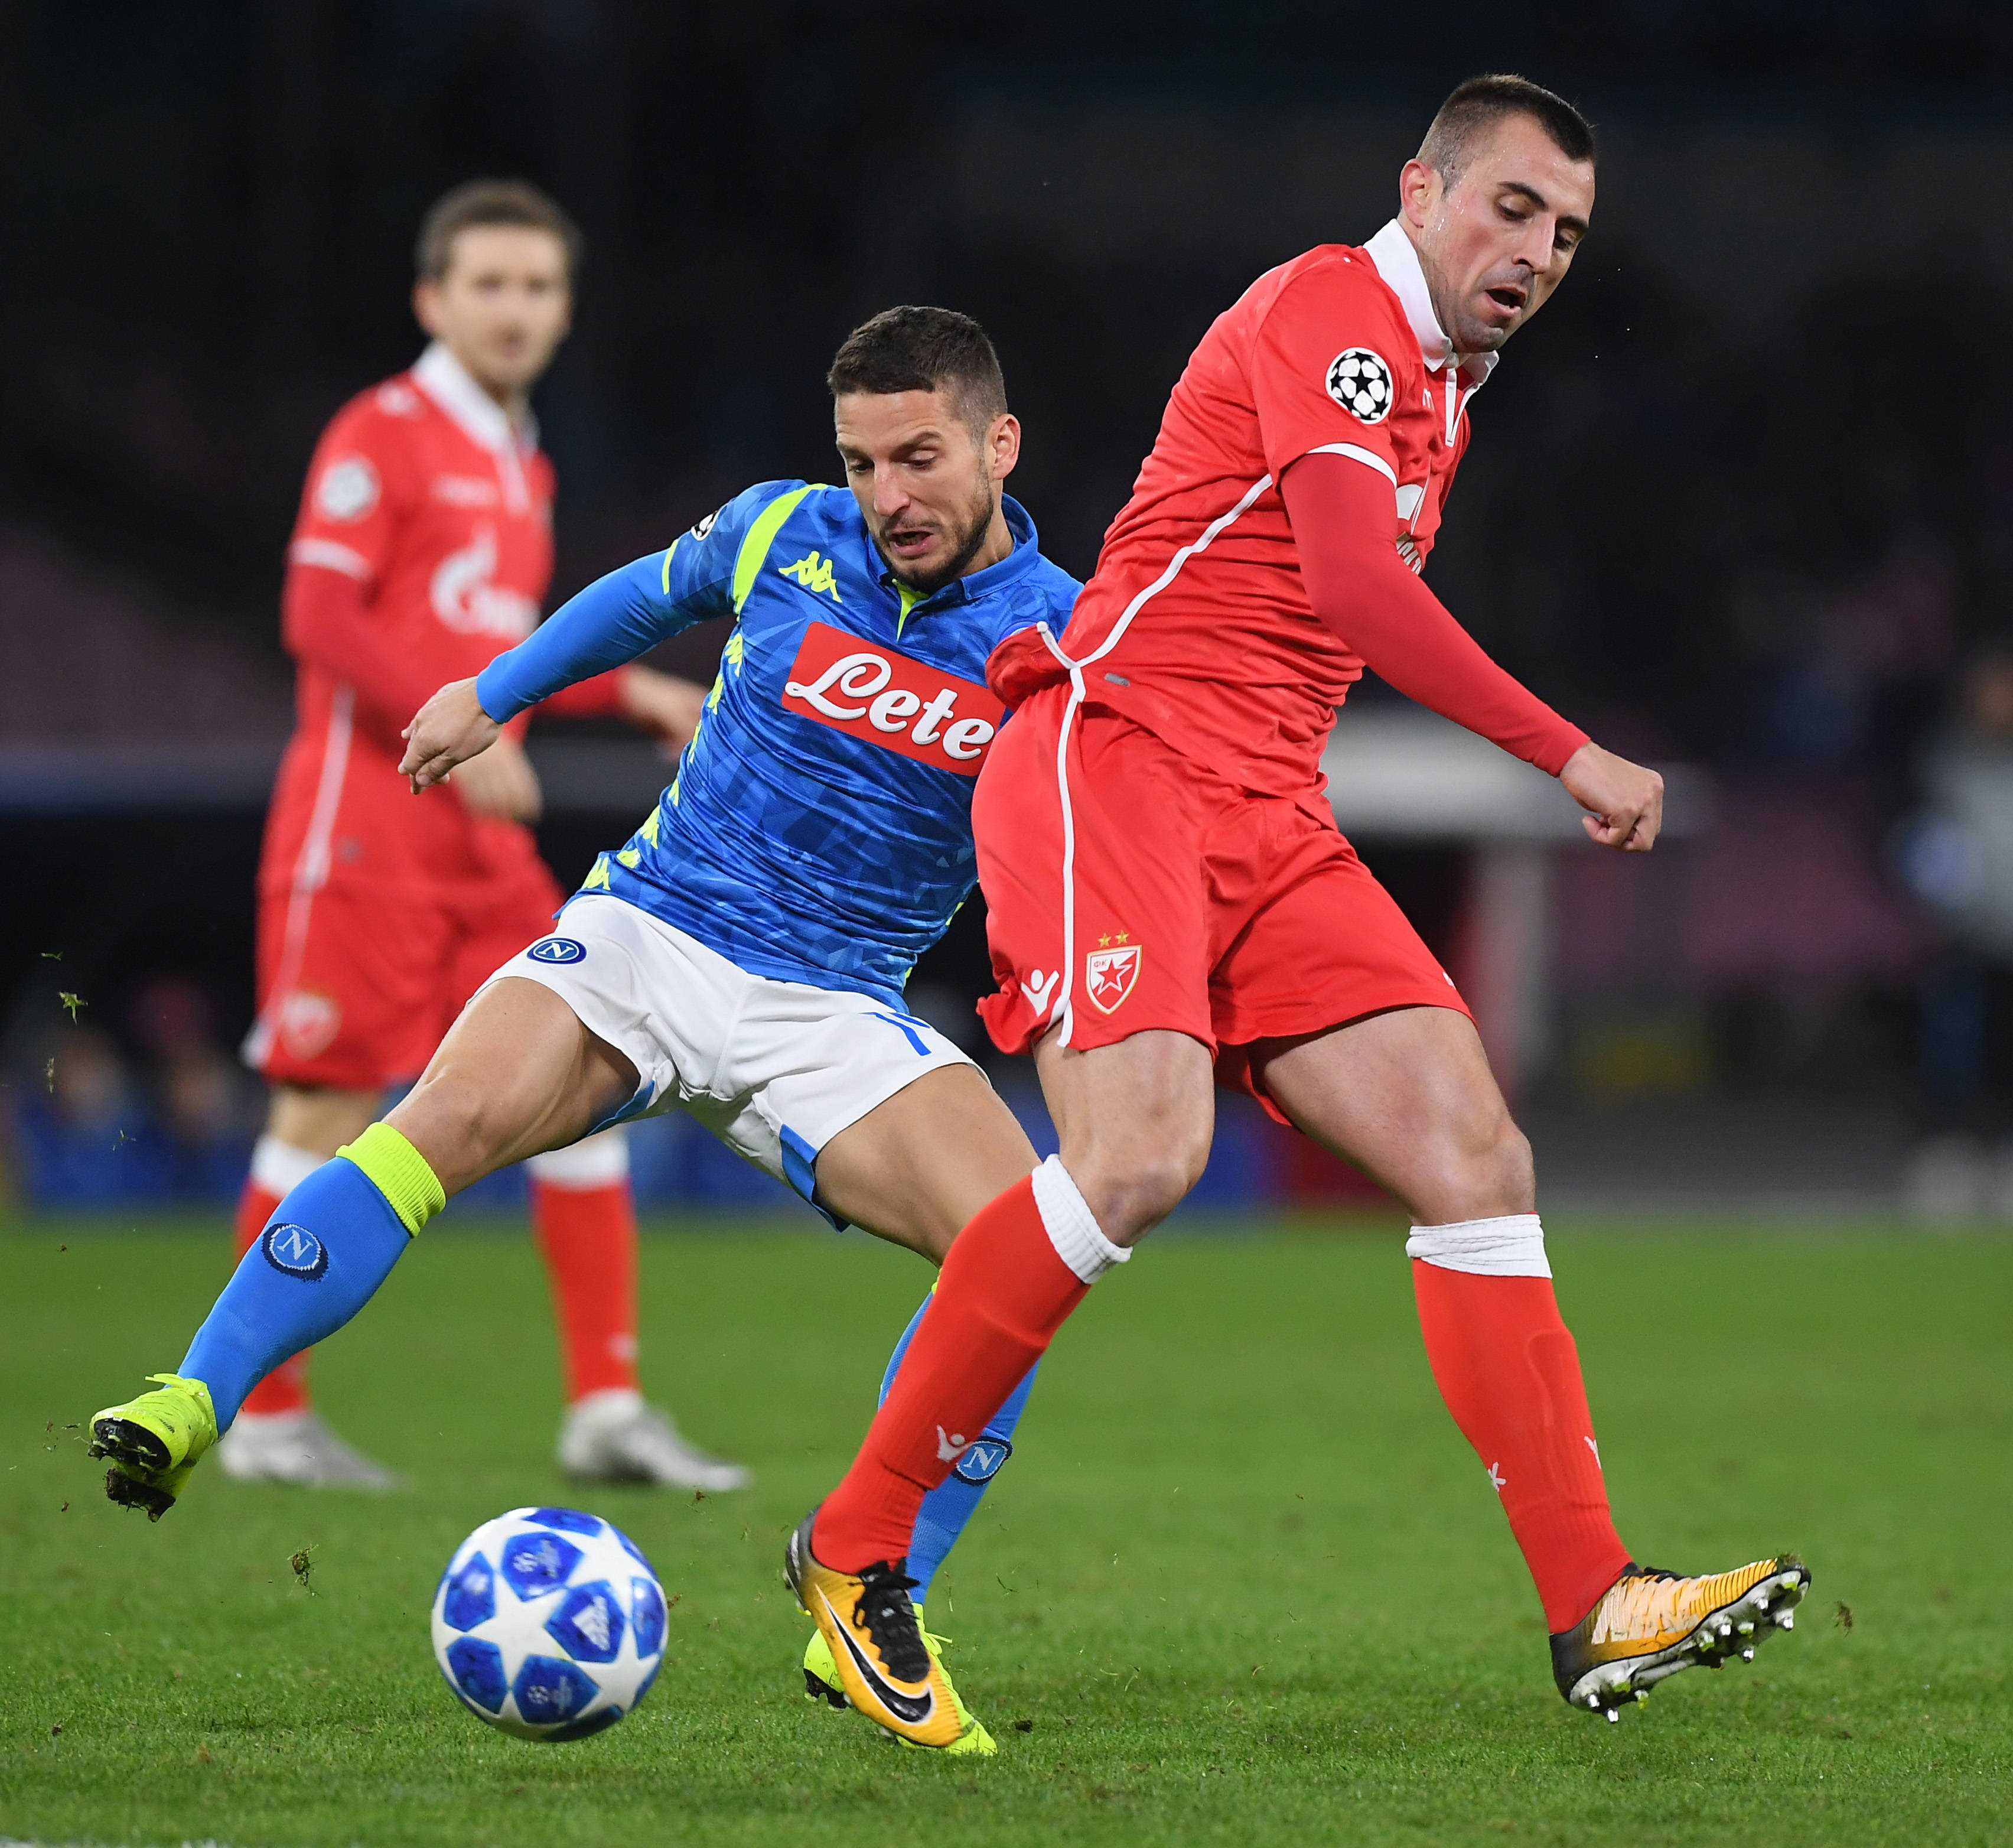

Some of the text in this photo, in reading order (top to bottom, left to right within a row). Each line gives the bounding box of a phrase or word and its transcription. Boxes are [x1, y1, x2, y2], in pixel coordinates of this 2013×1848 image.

[784, 652, 994, 760] Lete
[538, 942, 574, 958] N
[276, 1228, 313, 1260] N
[963, 1446, 1000, 1470] N
